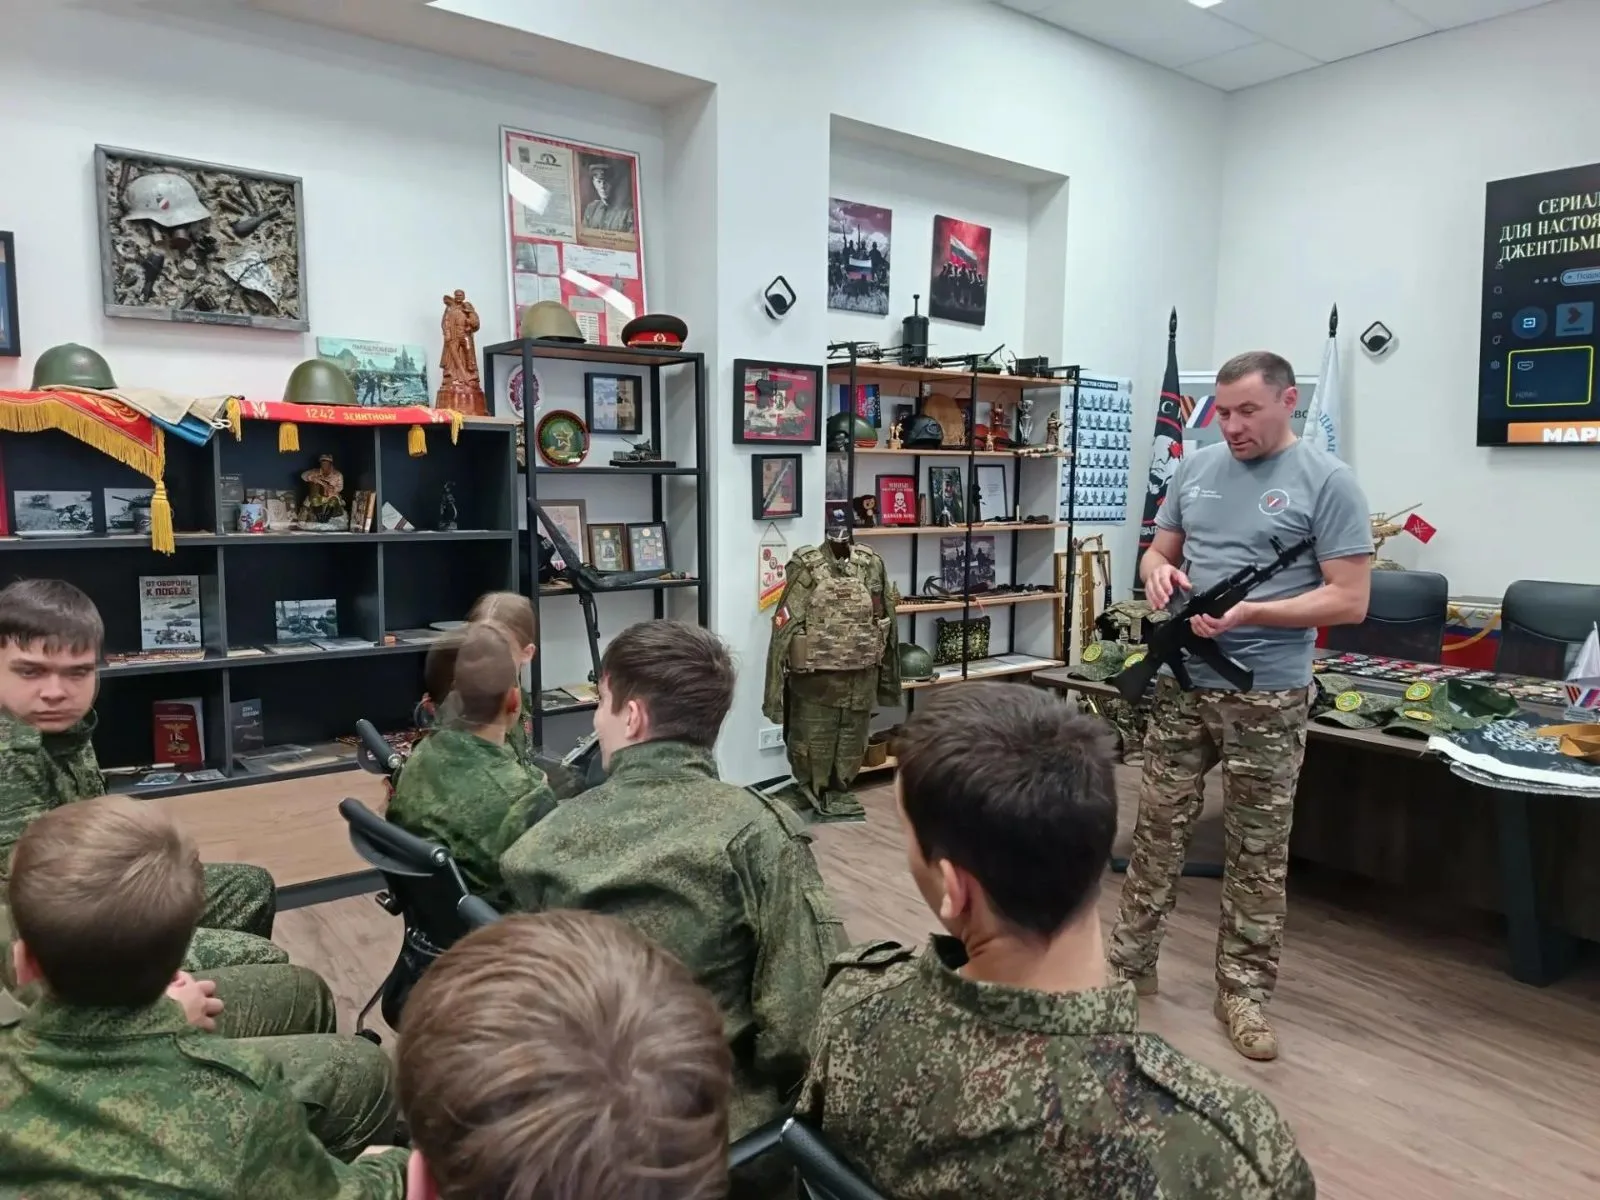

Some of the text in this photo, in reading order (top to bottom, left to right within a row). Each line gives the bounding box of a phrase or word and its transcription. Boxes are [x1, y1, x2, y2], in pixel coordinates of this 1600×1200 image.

[1499, 222, 1532, 243] ДЛЯ
[305, 408, 397, 421] 1242 ЗЕНИТНОМУ
[1543, 427, 1600, 442] МАР
[156, 579, 192, 587] ОБОРОНЫ
[146, 587, 192, 596] К ПОБЕДЕ
